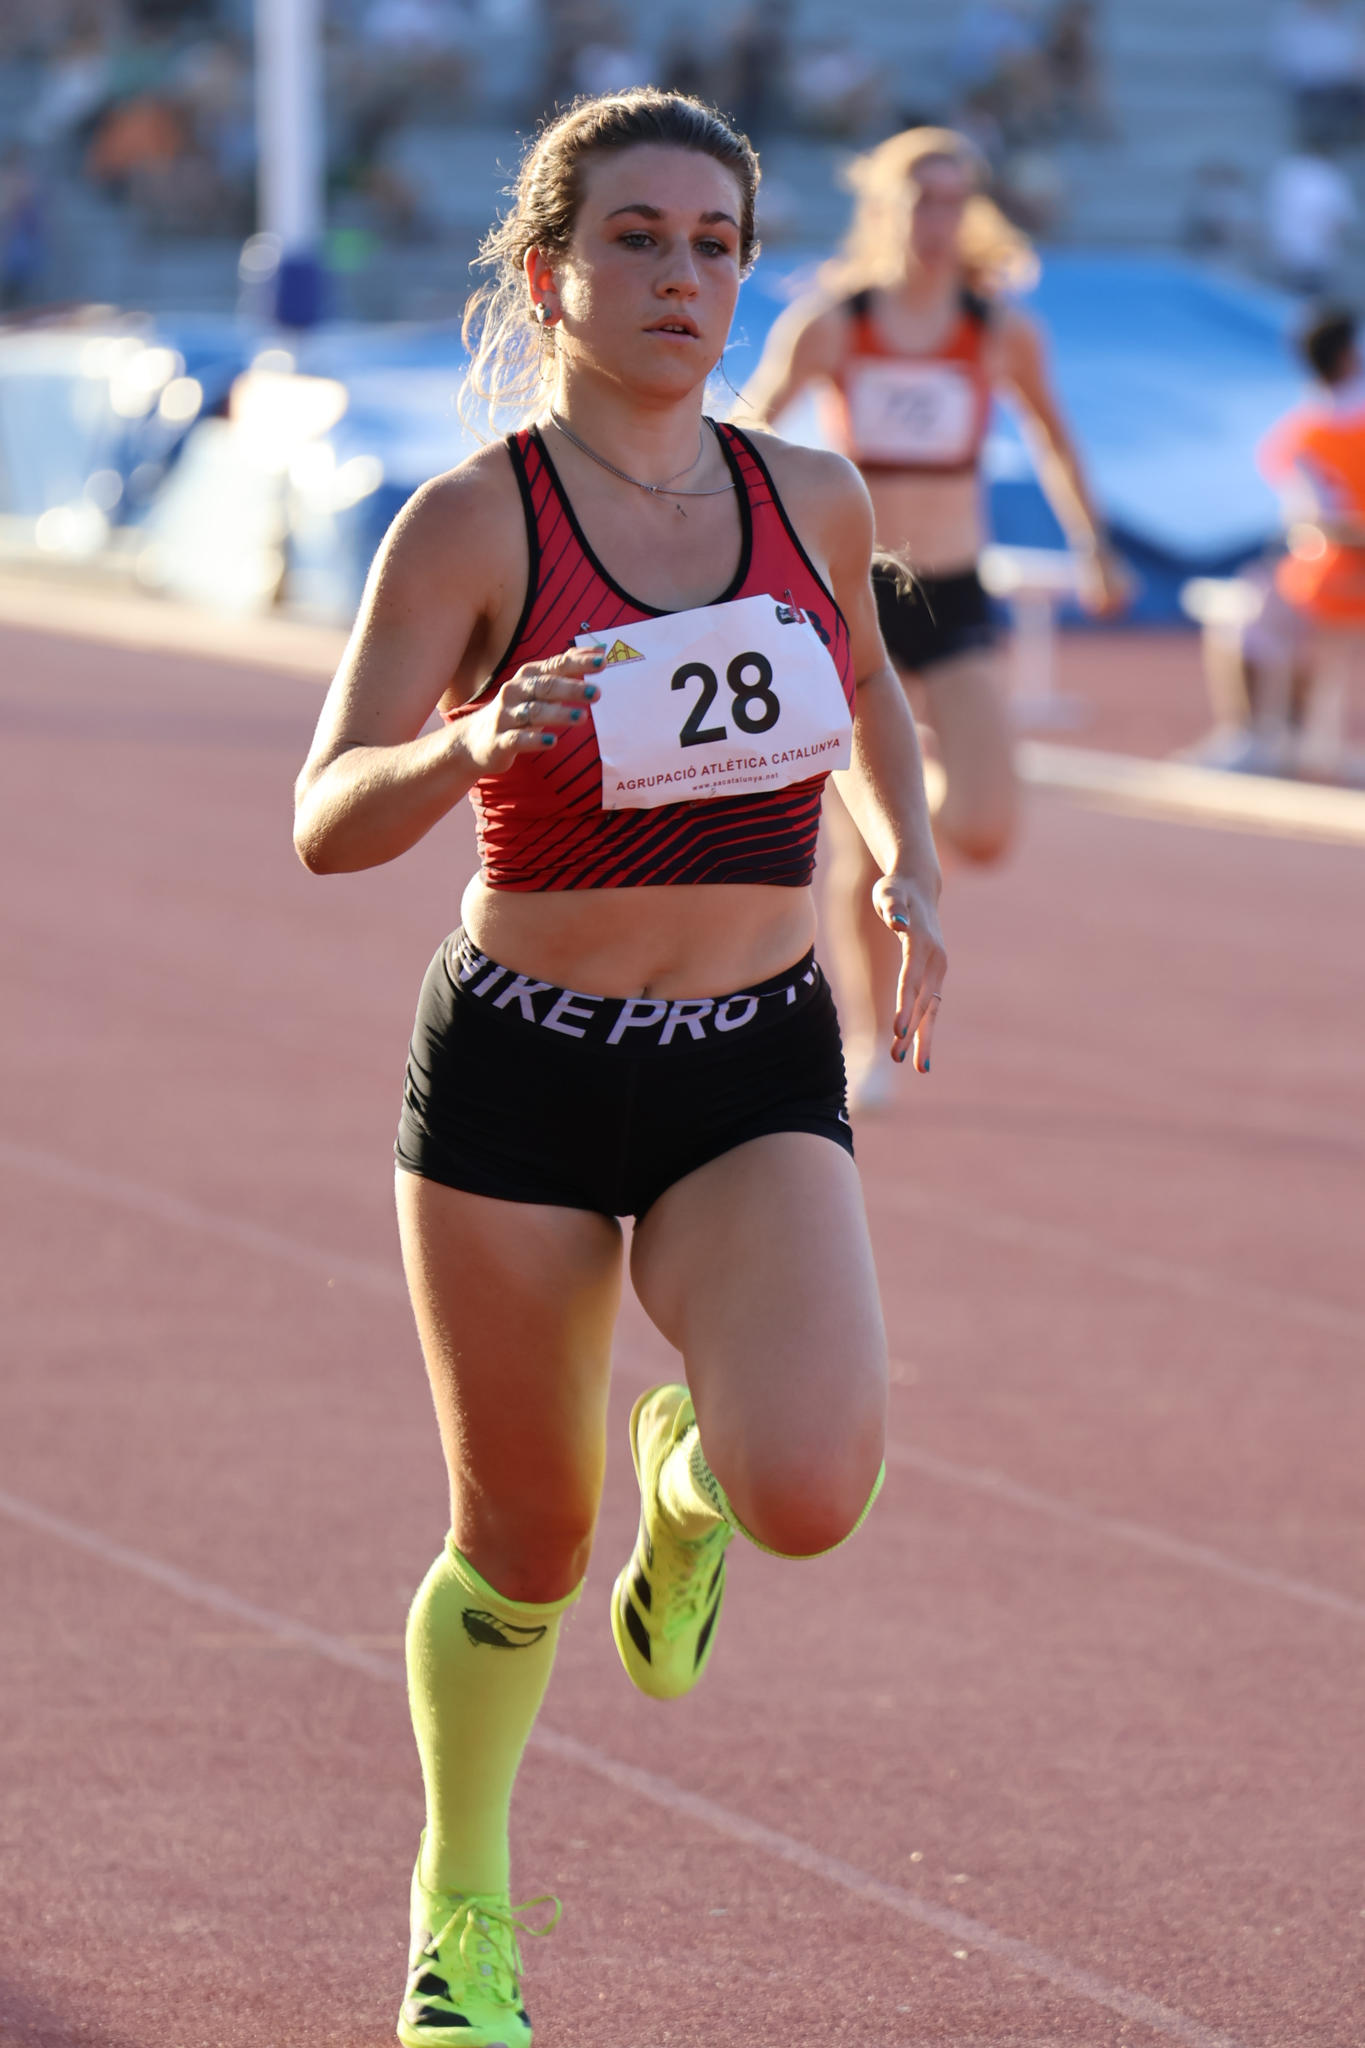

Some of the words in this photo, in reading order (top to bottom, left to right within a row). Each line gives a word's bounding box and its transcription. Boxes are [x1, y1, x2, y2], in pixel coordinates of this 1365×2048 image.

[671, 651, 780, 748] 28
[616, 766, 697, 791] AGRUPACIÓ
[772, 738, 840, 764] CATALUNYA
[606, 995, 760, 1045] PRO
